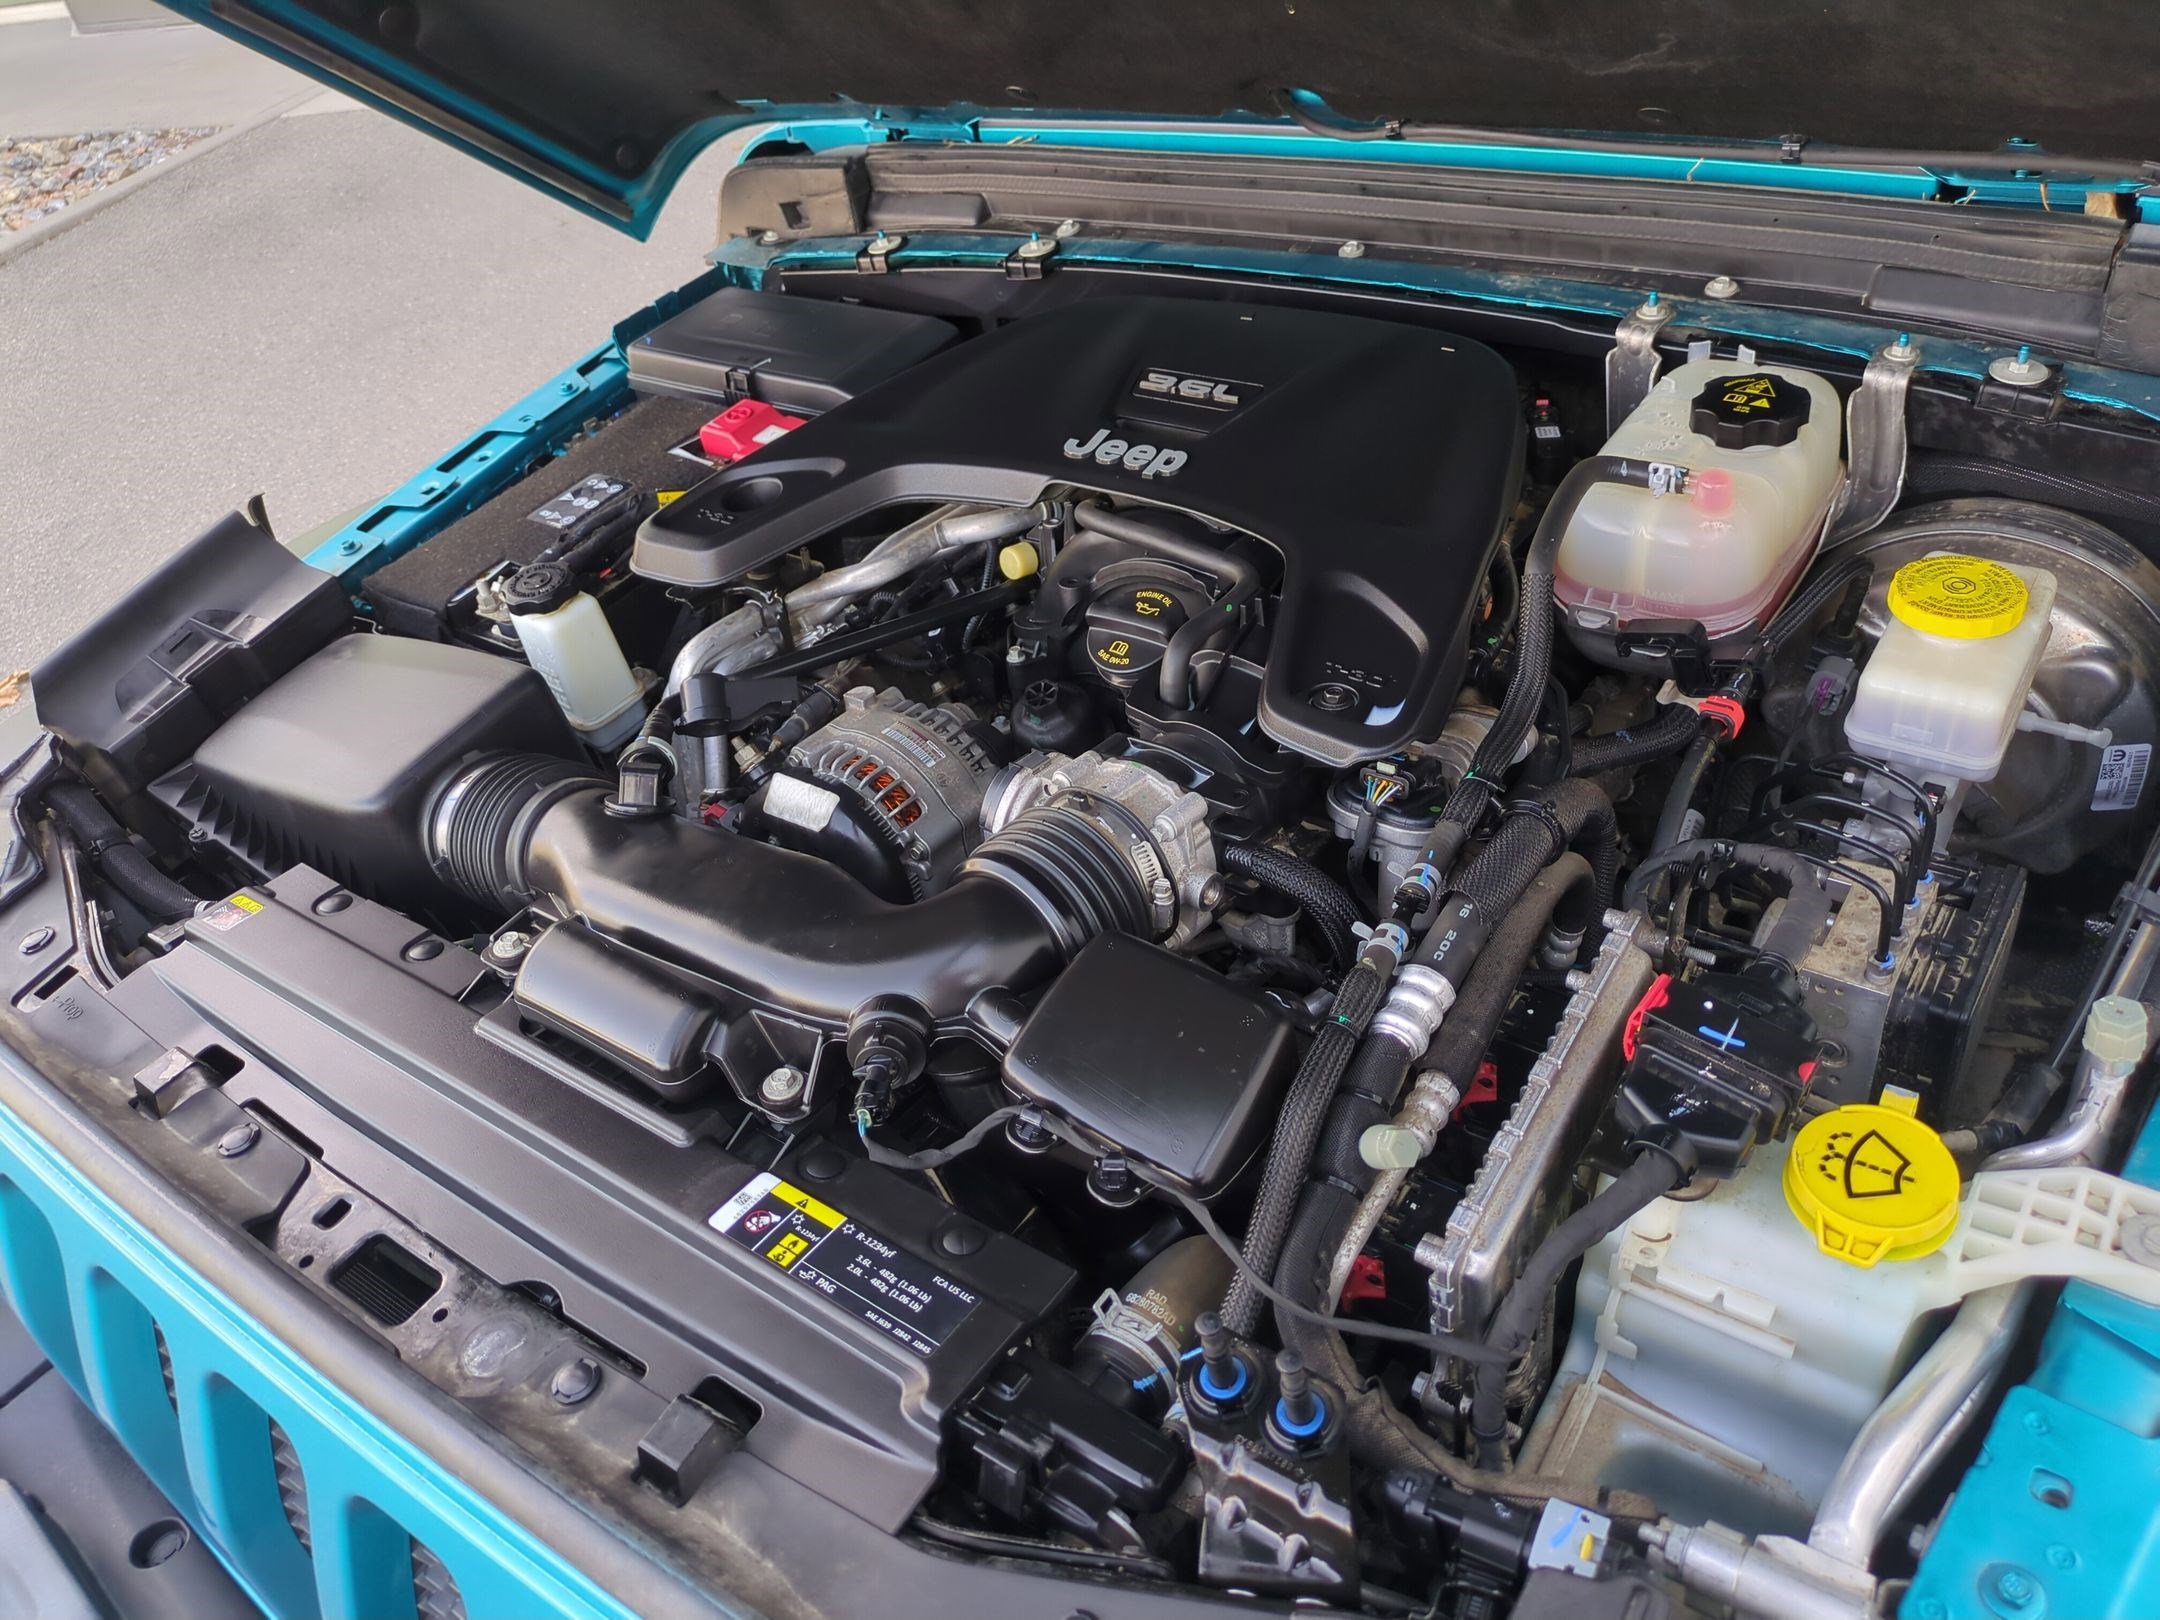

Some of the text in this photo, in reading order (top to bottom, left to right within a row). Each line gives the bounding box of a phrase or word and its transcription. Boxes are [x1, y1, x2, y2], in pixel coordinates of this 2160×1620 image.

[1139, 372, 1239, 404] 3.6L
[1063, 428, 1188, 480] Jeep
[1136, 591, 1173, 608] ENGINE OIL
[1097, 649, 1110, 661] SAE
[795, 1226, 821, 1242] R-1234yf
[855, 1232, 897, 1258] R-1234yf
[815, 1277, 837, 1294] PAG
[846, 1263, 863, 1277] 2.0L
[870, 1277, 889, 1293] 482g
[889, 1288, 910, 1305] (1.06
[908, 1300, 924, 1313] Lb)
[855, 1254, 872, 1269] 3.6L
[879, 1268, 898, 1284] 482g
[898, 1279, 920, 1296] (1.06
[919, 1291, 932, 1304] Lb)
[932, 1275, 976, 1304] FCA US LLC
[1145, 1288, 1168, 1304] RAD
[865, 1310, 879, 1322] SAE
